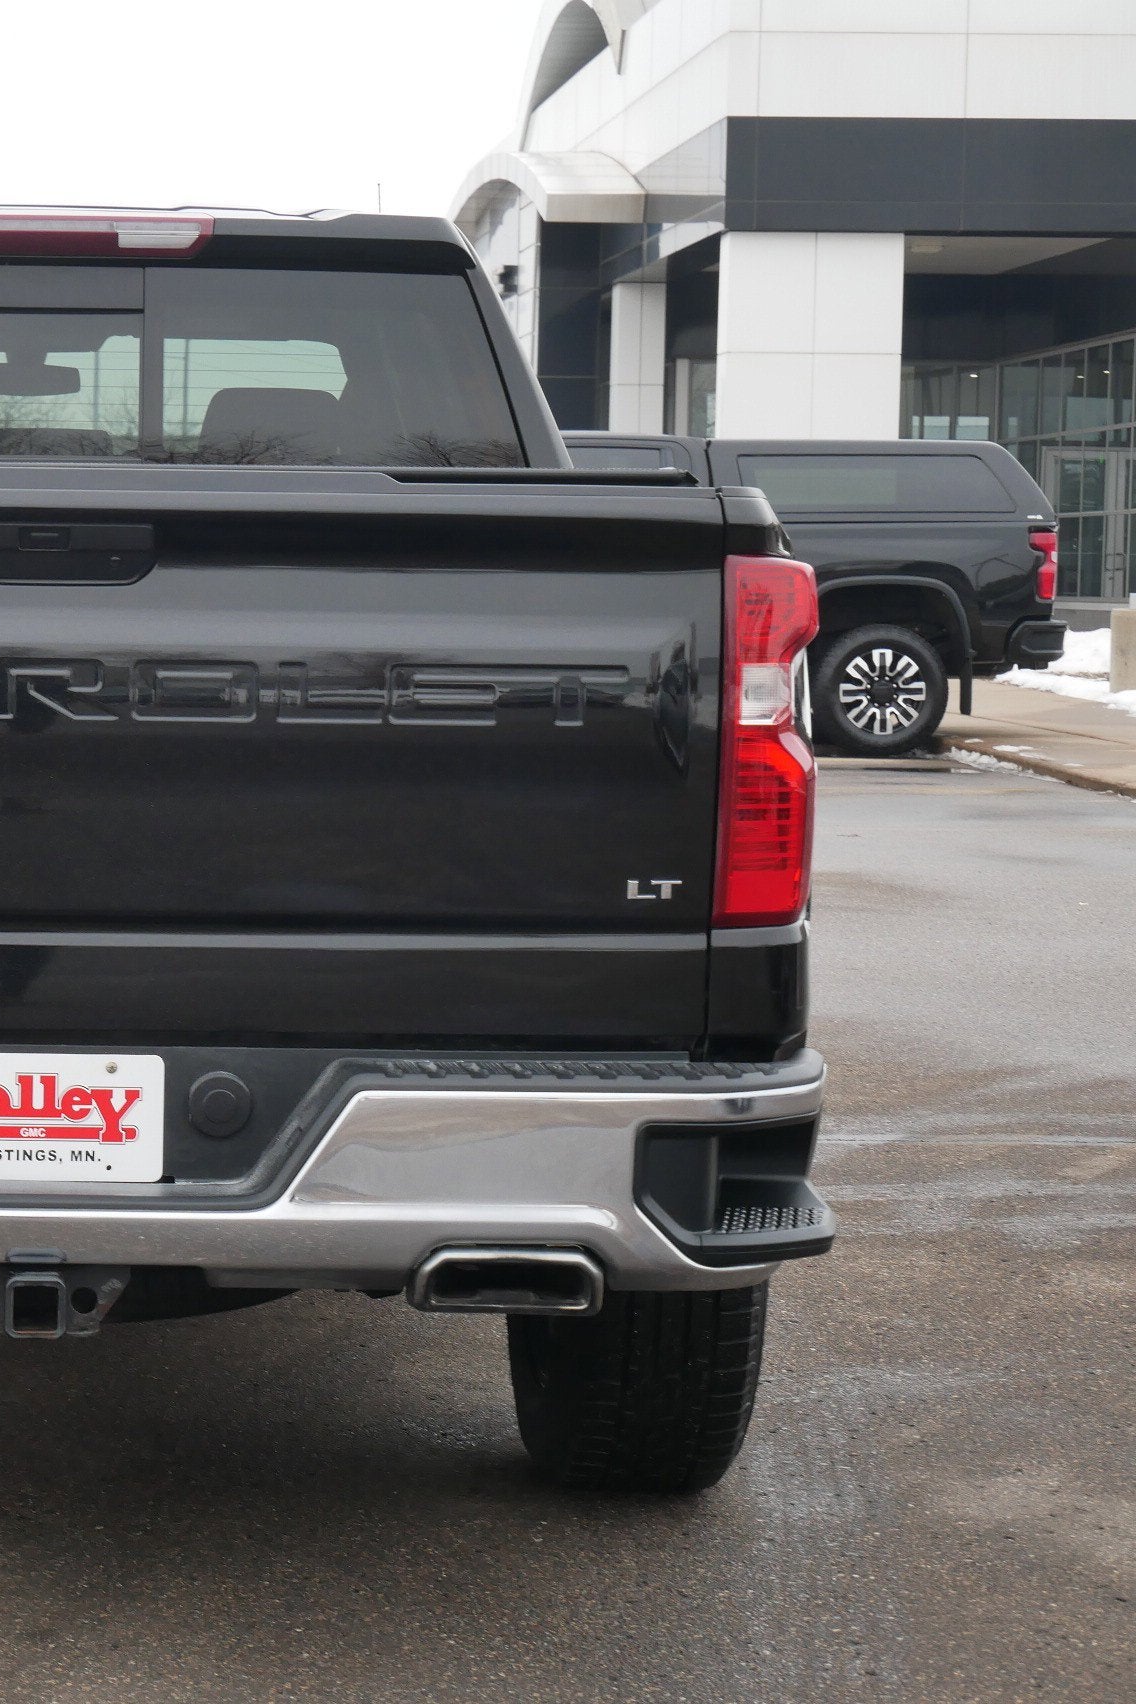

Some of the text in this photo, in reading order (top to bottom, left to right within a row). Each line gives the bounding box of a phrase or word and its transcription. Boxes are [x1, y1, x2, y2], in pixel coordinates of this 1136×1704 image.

[626, 879, 683, 899] LT
[19, 1127, 47, 1138] GMC
[70, 1150, 101, 1162] MN.
